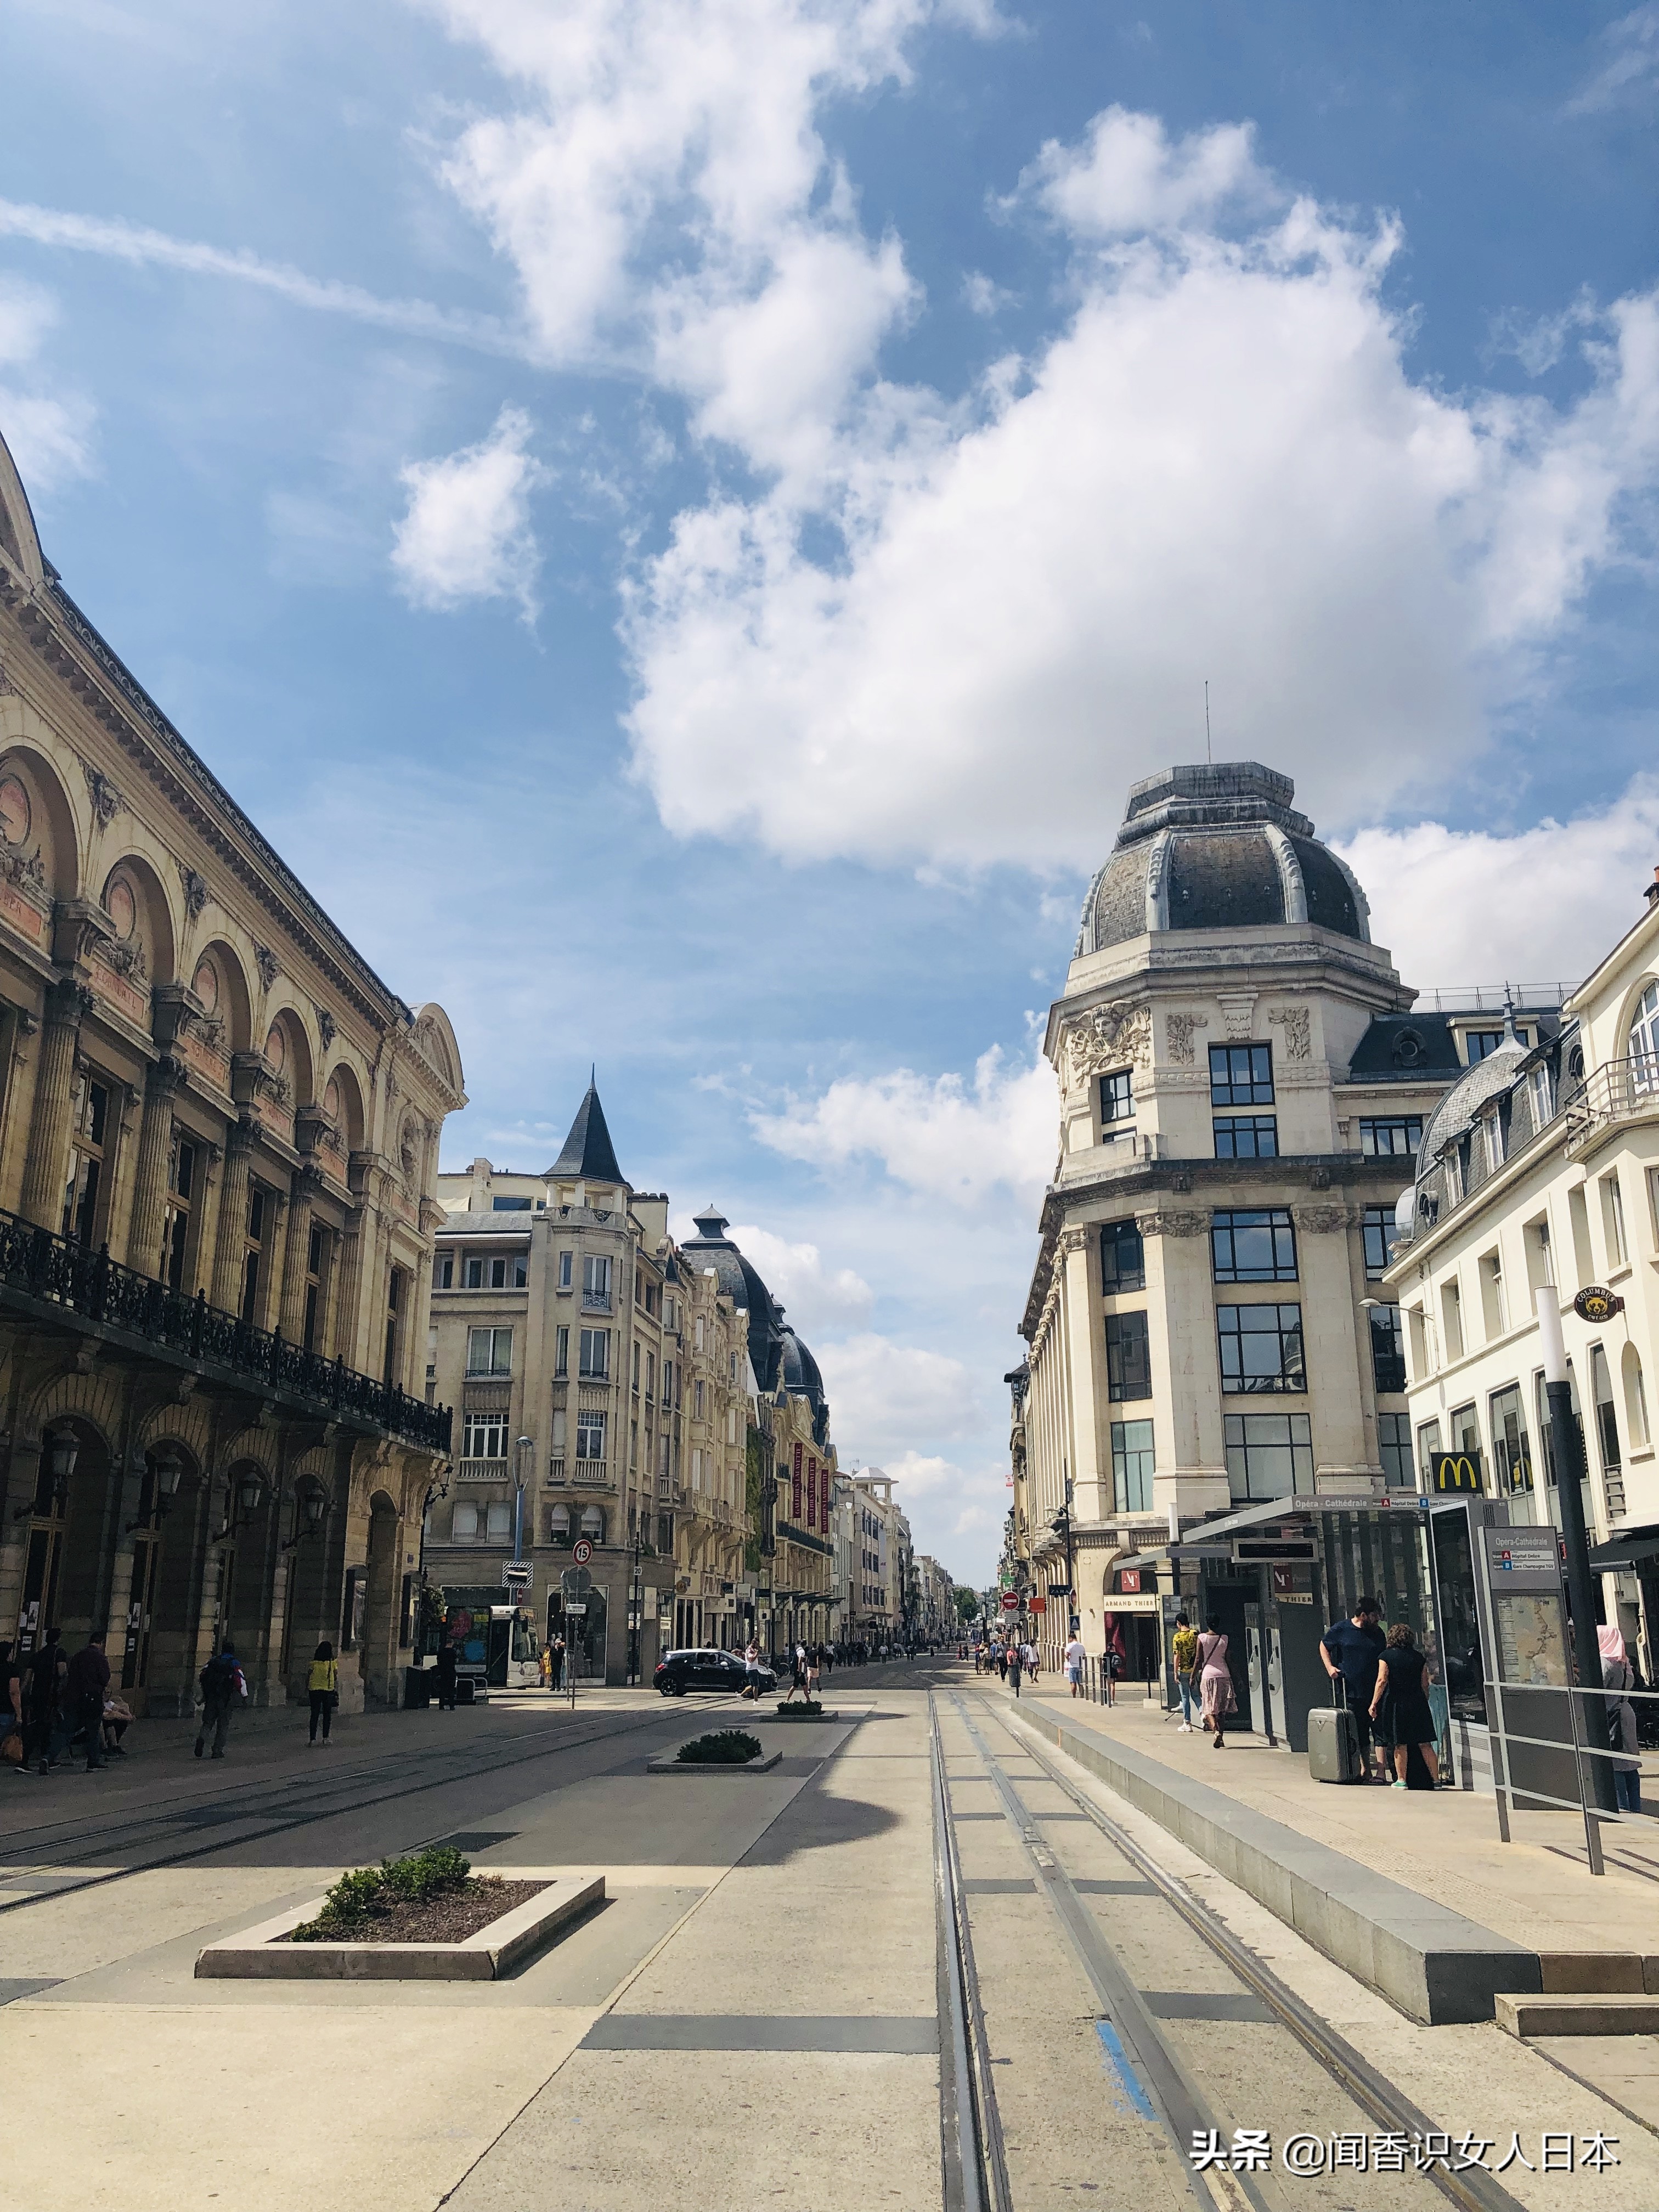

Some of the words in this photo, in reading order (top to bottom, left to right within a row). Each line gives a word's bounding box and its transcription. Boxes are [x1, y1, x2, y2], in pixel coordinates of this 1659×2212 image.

[1577, 1288, 1615, 1302] COLUMBUS
[1295, 1500, 1318, 1509] Opéra
[1325, 1499, 1367, 1507] Cathédrale
[578, 1548, 588, 1558] 15
